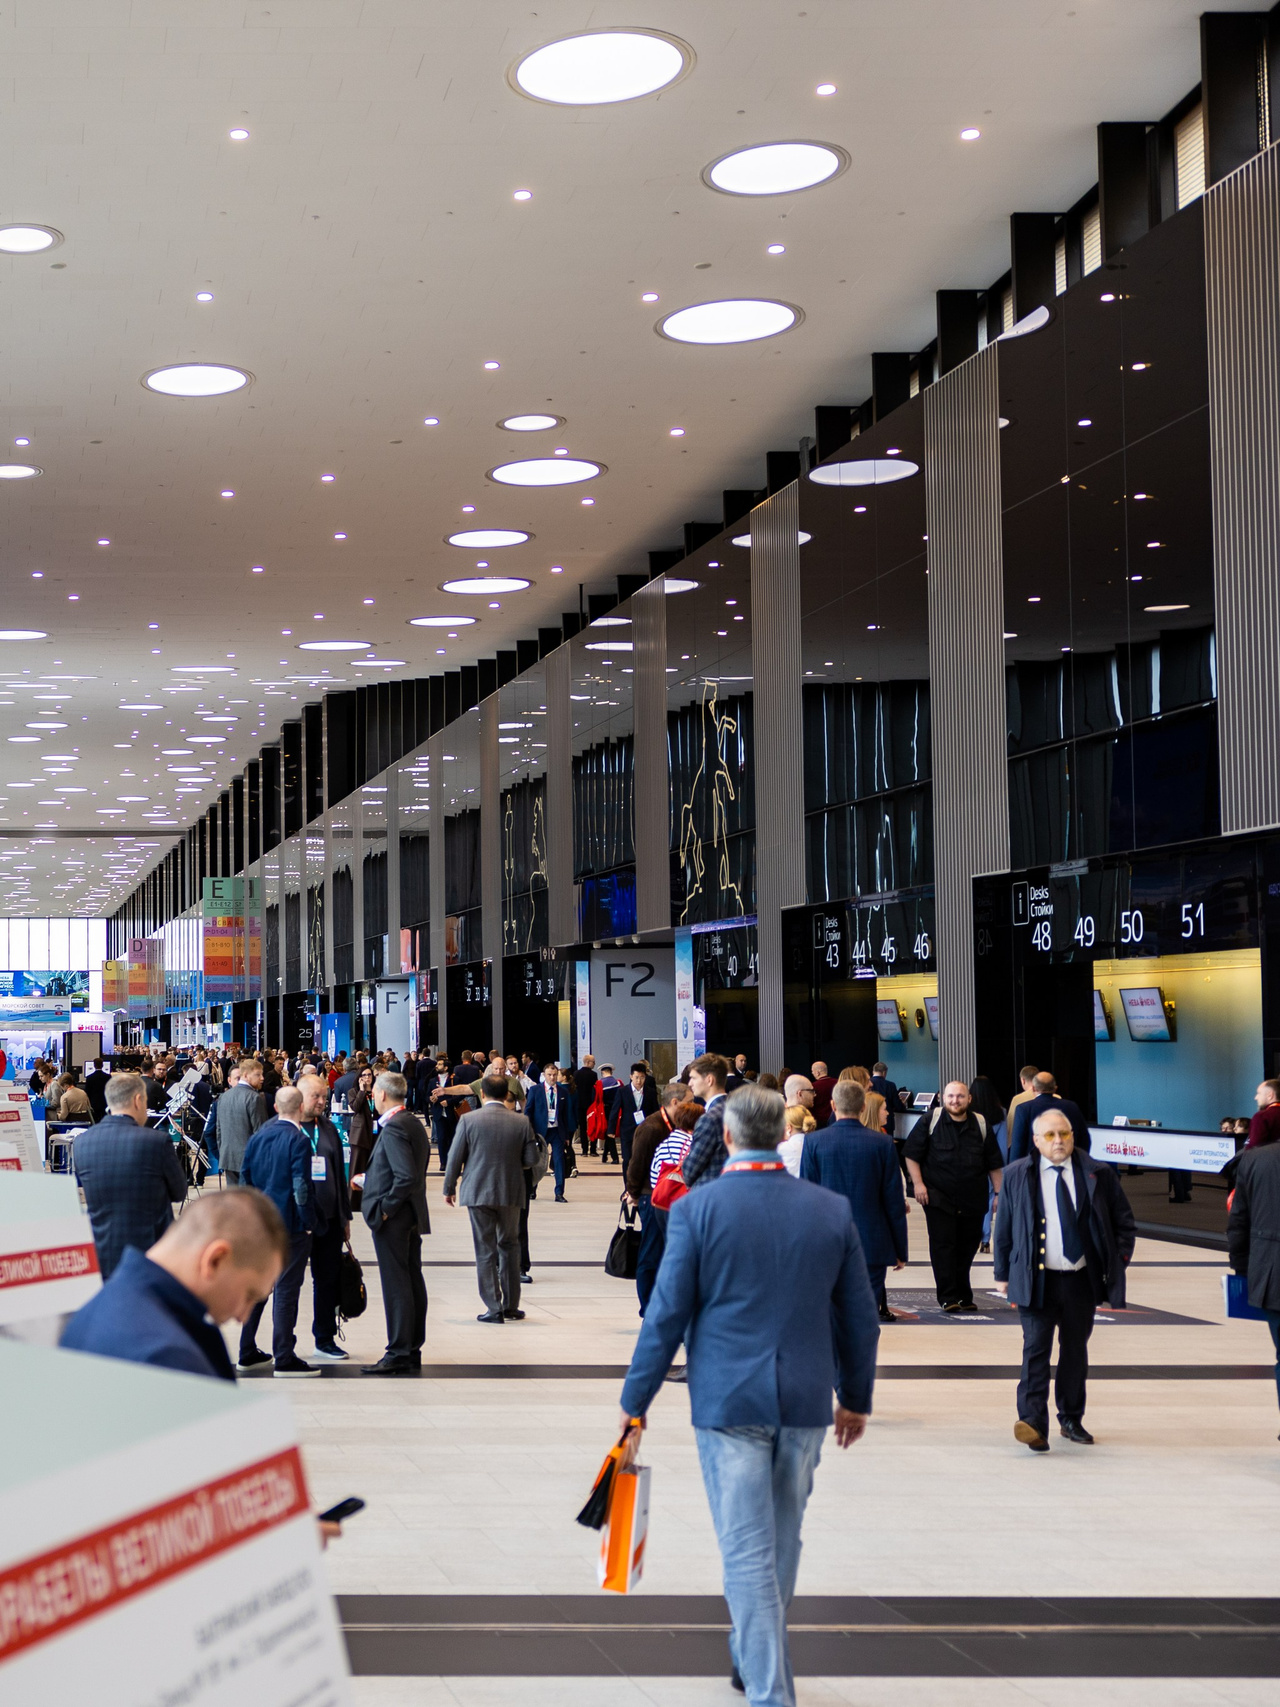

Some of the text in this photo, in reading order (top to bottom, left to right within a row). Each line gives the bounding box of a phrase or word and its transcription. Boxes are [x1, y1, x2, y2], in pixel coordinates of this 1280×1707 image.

[212, 880, 224, 898] E
[1030, 885, 1049, 900] Desks
[1030, 902, 1054, 917] Стойки
[825, 917, 838, 928] Desks
[1032, 903, 1205, 951] 48 49 50 51
[825, 930, 841, 942] Стойки
[133, 940, 142, 952] D
[826, 933, 929, 967] 43 44 45 46
[105, 960, 112, 971] C
[727, 952, 759, 976] 40 41
[605, 962, 656, 998] F2
[525, 981, 532, 997] 37
[298, 1028, 313, 1038] 25
[1105, 1143, 1121, 1155] НЕВА
[1128, 1144, 1145, 1157] NEVA
[42, 1249, 90, 1276] ПОБЕДЫ
[110, 1490, 214, 1588] ВЕЛИКОЙ
[217, 1460, 300, 1534] ПОБЕДЫ
